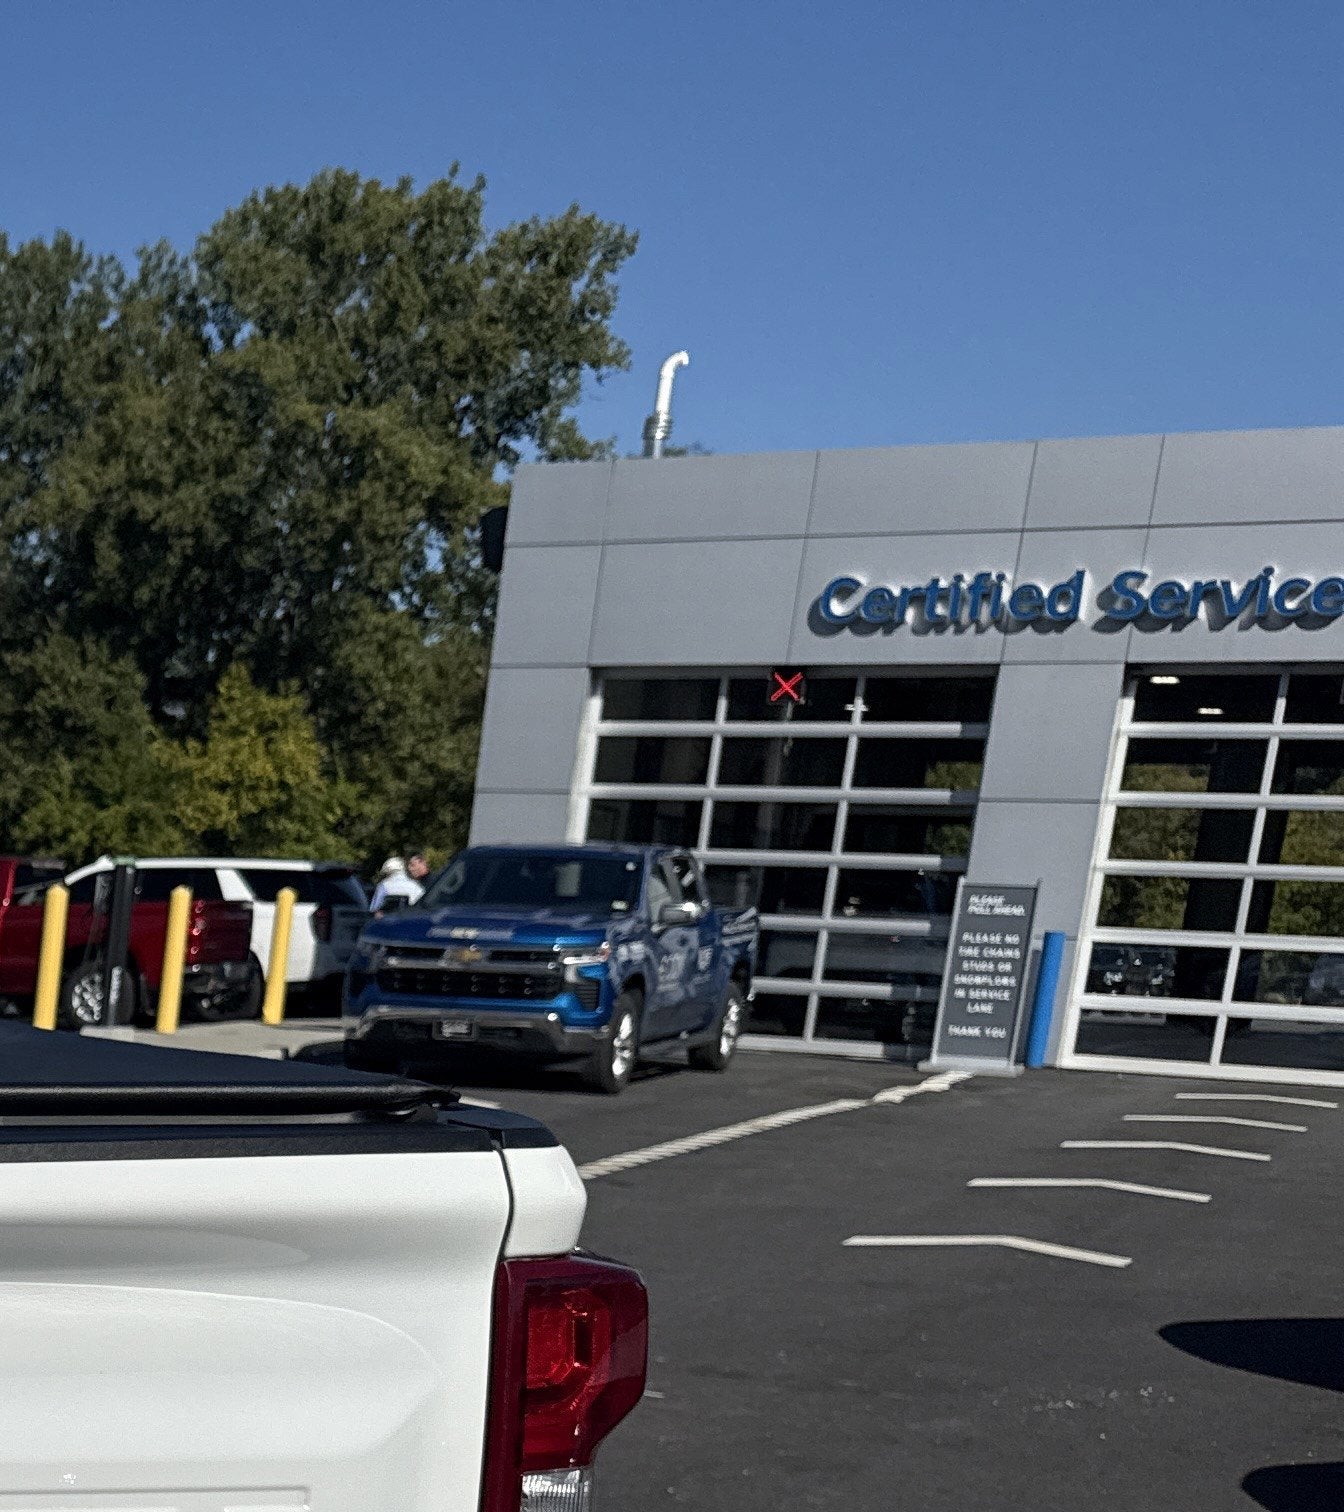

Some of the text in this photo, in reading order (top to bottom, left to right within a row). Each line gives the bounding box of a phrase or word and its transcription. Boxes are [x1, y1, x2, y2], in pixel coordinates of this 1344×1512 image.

[817, 565, 1344, 624] Certified Service
[962, 932, 1020, 945] PLEASE NO
[982, 947, 1021, 959] CHAINS
[968, 988, 1011, 1001] SERVICE
[966, 1002, 994, 1013] LANE
[948, 1024, 1007, 1038] THANK YOU
